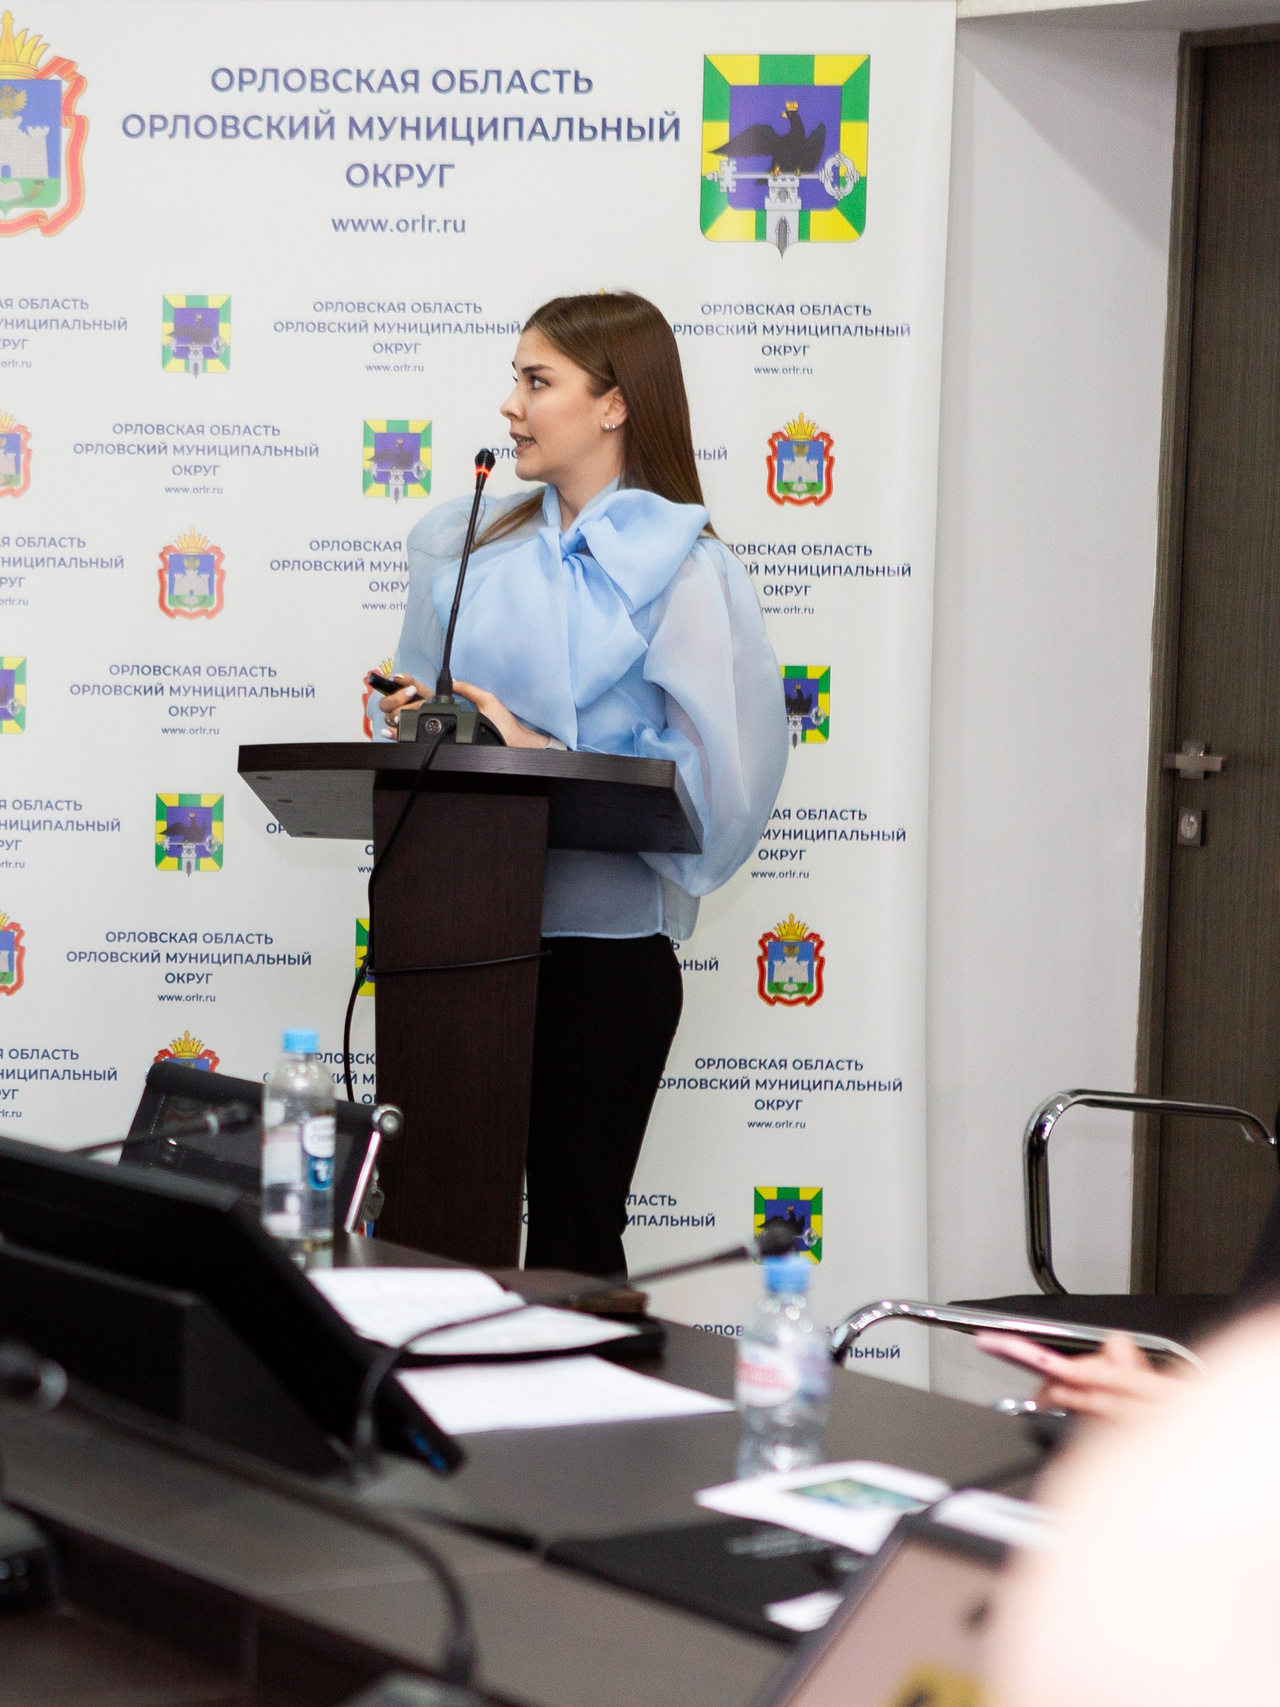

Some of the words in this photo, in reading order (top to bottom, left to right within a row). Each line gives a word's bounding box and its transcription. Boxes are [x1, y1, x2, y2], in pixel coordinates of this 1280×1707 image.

[211, 67, 420, 94] ОРЛОВСКАЯ
[432, 68, 593, 94] ОБЛАСТЬ
[122, 109, 335, 140] ОРЛОВСКИЙ
[348, 110, 680, 146] МУНИЦИПАЛЬНЫЙ
[345, 163, 455, 188] ОКРУГ
[331, 214, 466, 233] www.orlr.ru
[18, 297, 89, 309] ОБЛАСТЬ
[313, 301, 406, 314] ОРЛОВСКАЯ
[411, 301, 482, 314] ОБЛАСТЬ
[701, 303, 795, 316] ОРЛОВСКАЯ
[800, 303, 872, 316] ОБЛАСТЬ
[273, 318, 368, 334] ОРЛОВСКИЙ
[374, 320, 521, 337] МУНИЦИПАЛЬНЫЙ
[762, 324, 910, 338] МУНИЦИПАЛЬНЫЙ
[373, 342, 421, 354] ОКРУГ
[761, 344, 810, 356] ОКРУГ
[365, 362, 425, 372] www.orlr.ru
[753, 364, 814, 375] www.orlr.ru
[112, 423, 205, 436] ОРЛОВСКАЯ
[210, 423, 280, 436] ОБЛАСТЬ
[73, 442, 168, 455] ОРЛОВСКИЙ
[173, 444, 319, 456] МУНИЦИПАЛЬНЫЙ
[172, 465, 220, 476] ОКРУГ
[164, 484, 223, 494] www.orlr.ru
[15, 535, 86, 548] ОБЛАСТЬ
[309, 540, 402, 552] ОРЛОВСКАЯ
[801, 543, 873, 556] ОБЛАСТЬ
[269, 558, 365, 573] ОРЛОВСКИЙ
[764, 563, 912, 578] МУНИЦИПАЛЬНЫЙ
[763, 585, 812, 597] ОКРУГ
[109, 664, 201, 677] ОРЛОВСКАЯ
[206, 664, 277, 677] ОБЛАСТЬ
[70, 683, 164, 696] ОРЛОВСКИЙ
[169, 685, 315, 699] МУНИЦИПАЛЬНЫЙ
[168, 705, 216, 717] ОКРУГ
[160, 725, 220, 735] www.orlr.ru
[12, 798, 82, 811] ОБЛАСТЬ
[796, 808, 868, 821] ОБЛАСТЬ
[758, 848, 807, 861] ОКРУГ
[750, 868, 810, 880] www.orlr.ru
[105, 931, 198, 945] ОРЛОВСКАЯ
[202, 931, 274, 945] ОБЛАСТЬ
[66, 950, 161, 963] ОРЛОВСКИЙ
[165, 952, 312, 966] МУНИЦИПАЛЬНЫЙ
[164, 972, 213, 984] ОКРУГ
[156, 991, 217, 1003] www.orlr.ru
[8, 1047, 79, 1060] ОБЛАСТЬ
[694, 1057, 788, 1071] ОРЛОВСКАЯ
[792, 1057, 864, 1071] ОБЛАСТЬ
[658, 1076, 751, 1090] ОРЛОВСКИЙ
[755, 1078, 903, 1092] МУНИЦИПАЛЬНЫЙ
[754, 1098, 803, 1111] ОКРУГ
[746, 1118, 807, 1130] www.orlr.ru
